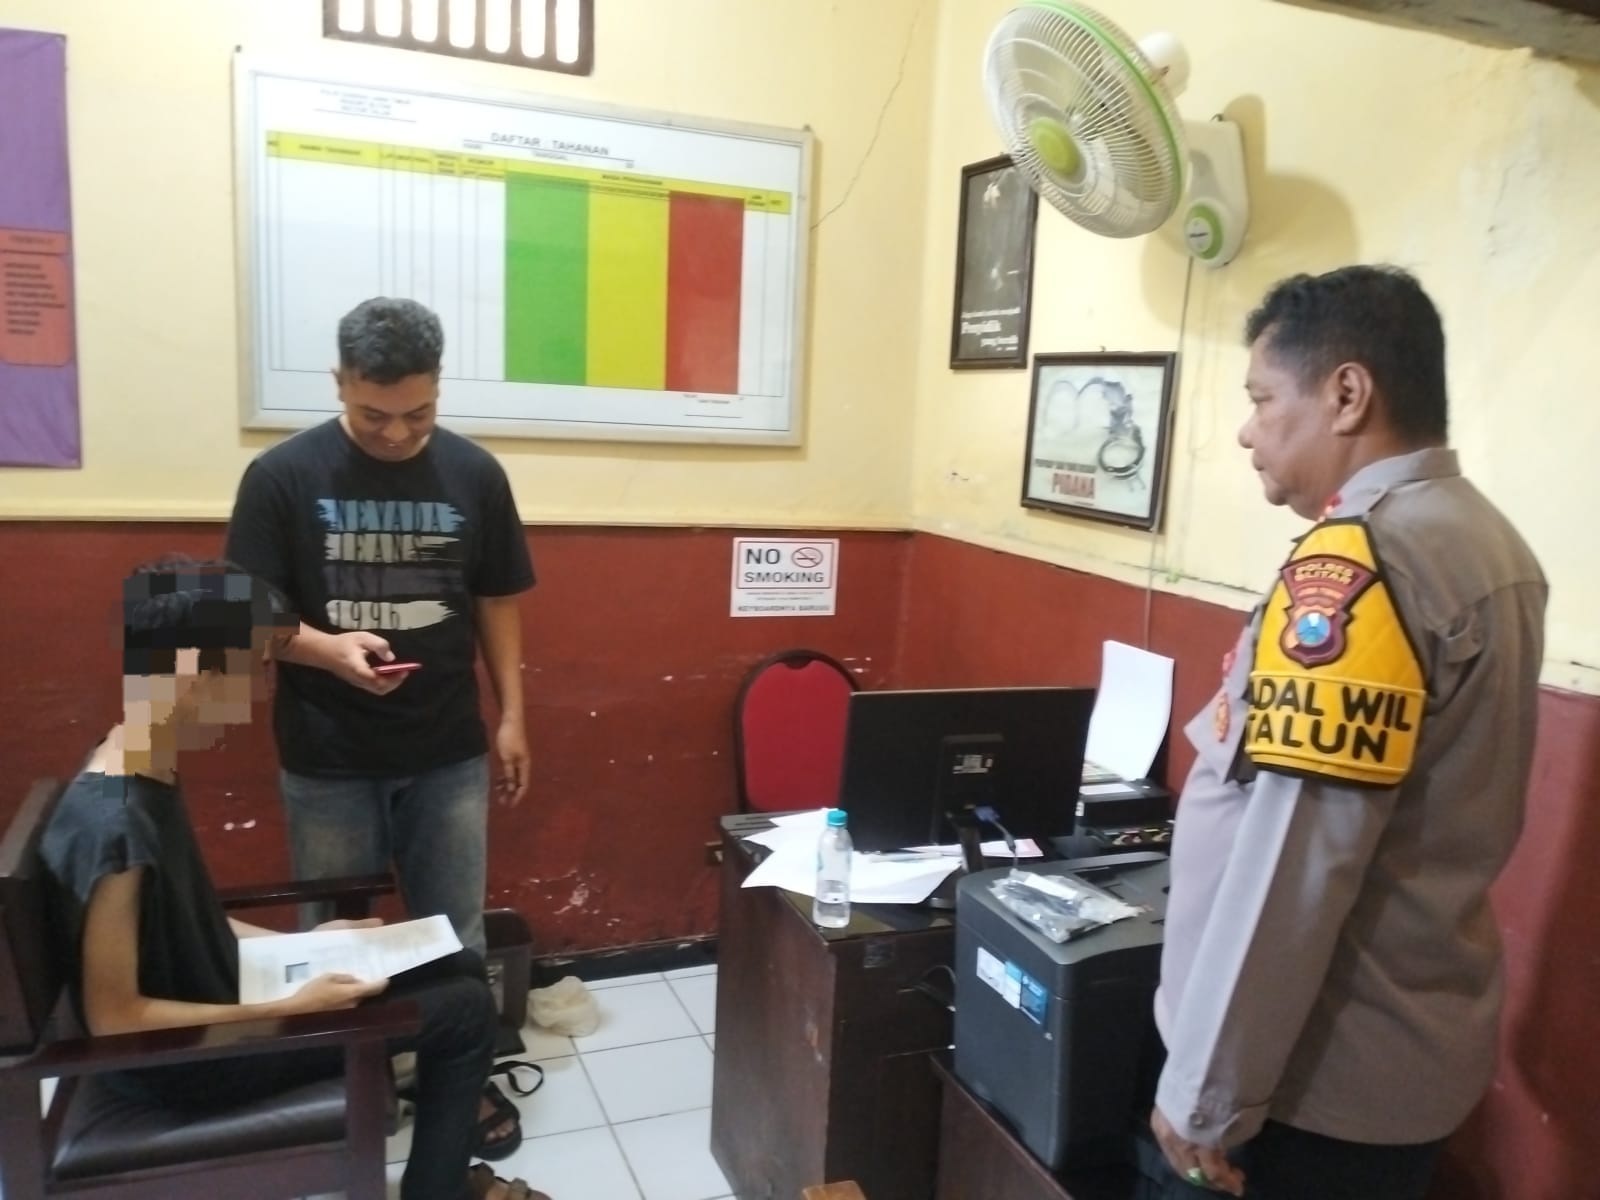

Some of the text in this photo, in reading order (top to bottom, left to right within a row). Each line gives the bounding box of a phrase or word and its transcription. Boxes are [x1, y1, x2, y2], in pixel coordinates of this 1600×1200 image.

[490, 132, 541, 147] DAFTAR
[552, 139, 610, 155] TAHANAN
[745, 548, 781, 565] NO
[744, 571, 825, 583] SMOKING
[335, 601, 400, 630] 1996
[1342, 685, 1413, 732] WIL
